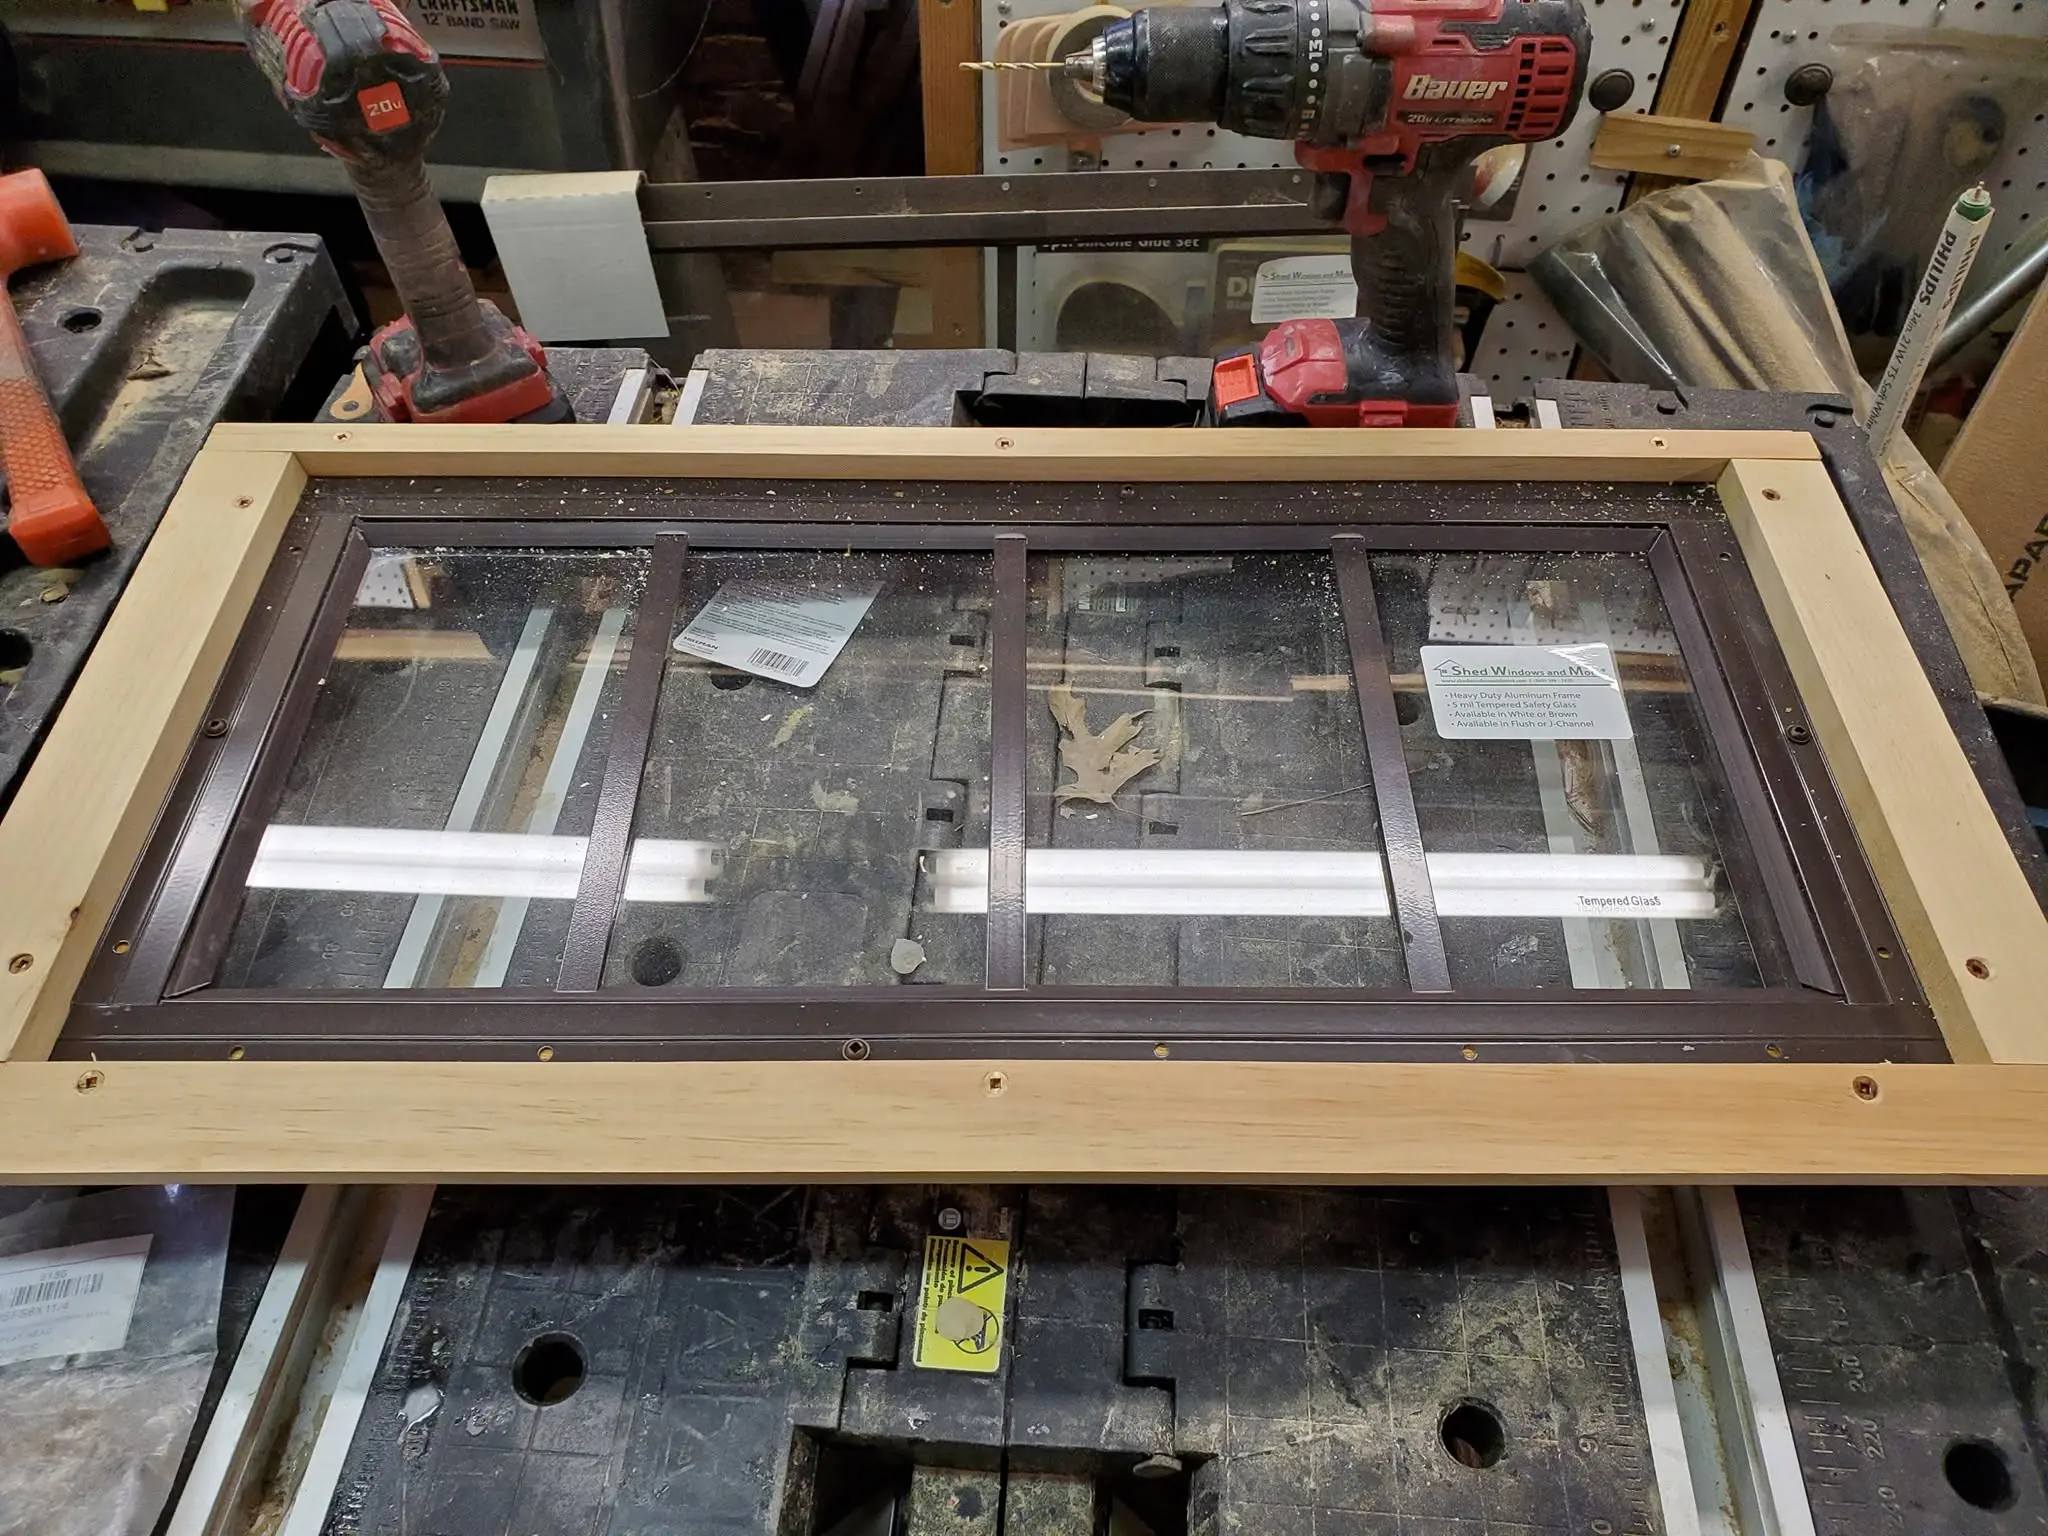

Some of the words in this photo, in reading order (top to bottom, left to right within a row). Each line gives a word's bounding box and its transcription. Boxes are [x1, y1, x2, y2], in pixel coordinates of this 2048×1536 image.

[418, 0, 519, 15] CRAFTSMAN
[446, 15, 486, 29] BAND
[490, 17, 520, 31] SAW
[1402, 73, 1508, 100] Bauer
[1919, 229, 1957, 306] PHILIPS
[1451, 665, 1488, 676] Shed
[1490, 665, 1545, 676] Windows
[1547, 668, 1566, 676] and
[1449, 691, 1478, 700] Heavy
[1480, 691, 1501, 700] Duty
[1504, 691, 1551, 700] Aluminum
[1552, 692, 1581, 700] Frame
[1459, 701, 1474, 709] mil
[1475, 701, 1521, 709] Tempered
[1523, 701, 1551, 709] Safety
[1552, 701, 1577, 709] Glass
[1454, 710, 1496, 718] Available
[1508, 710, 1535, 718] White
[1549, 710, 1578, 718] Brown
[1456, 720, 1499, 728] Available
[1511, 720, 1535, 728] Flush
[1549, 720, 1594, 728] J-Channel
[1578, 895, 1630, 907] Tempered
[1631, 895, 1661, 906] Glass
